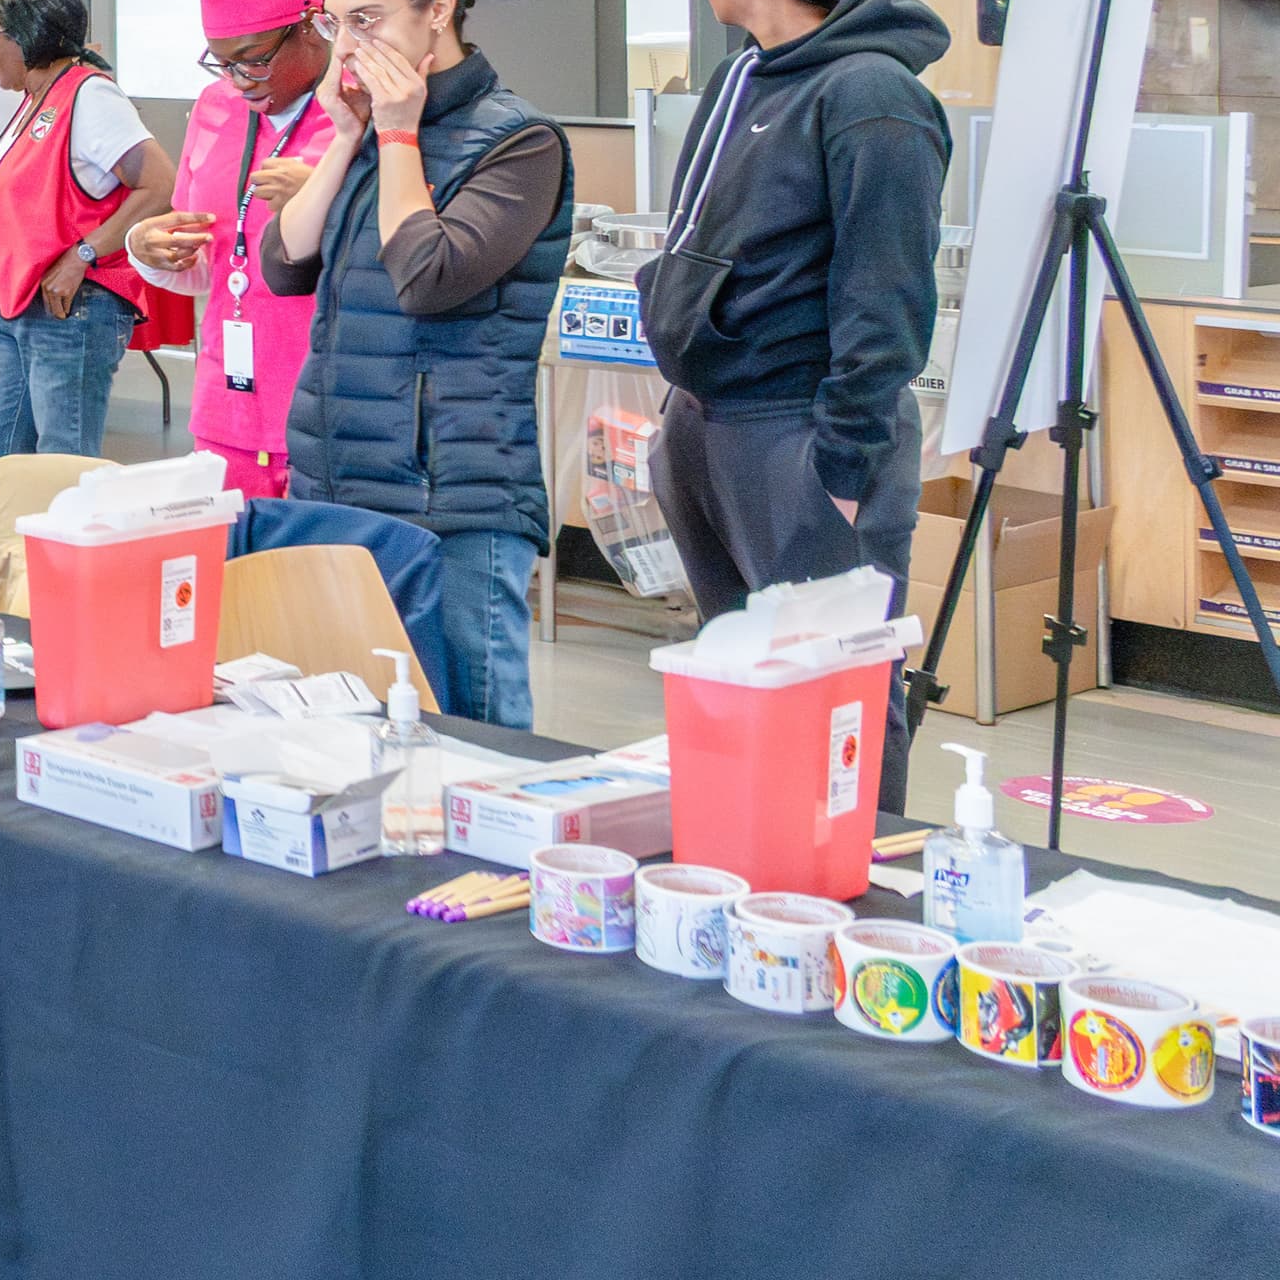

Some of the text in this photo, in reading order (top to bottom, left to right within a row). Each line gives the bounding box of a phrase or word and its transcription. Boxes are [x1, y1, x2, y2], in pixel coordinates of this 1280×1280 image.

[1224, 387, 1252, 396] GRAB
[1253, 389, 1262, 397] A
[1224, 459, 1252, 469] GRAB
[1232, 534, 1251, 543] RAB
